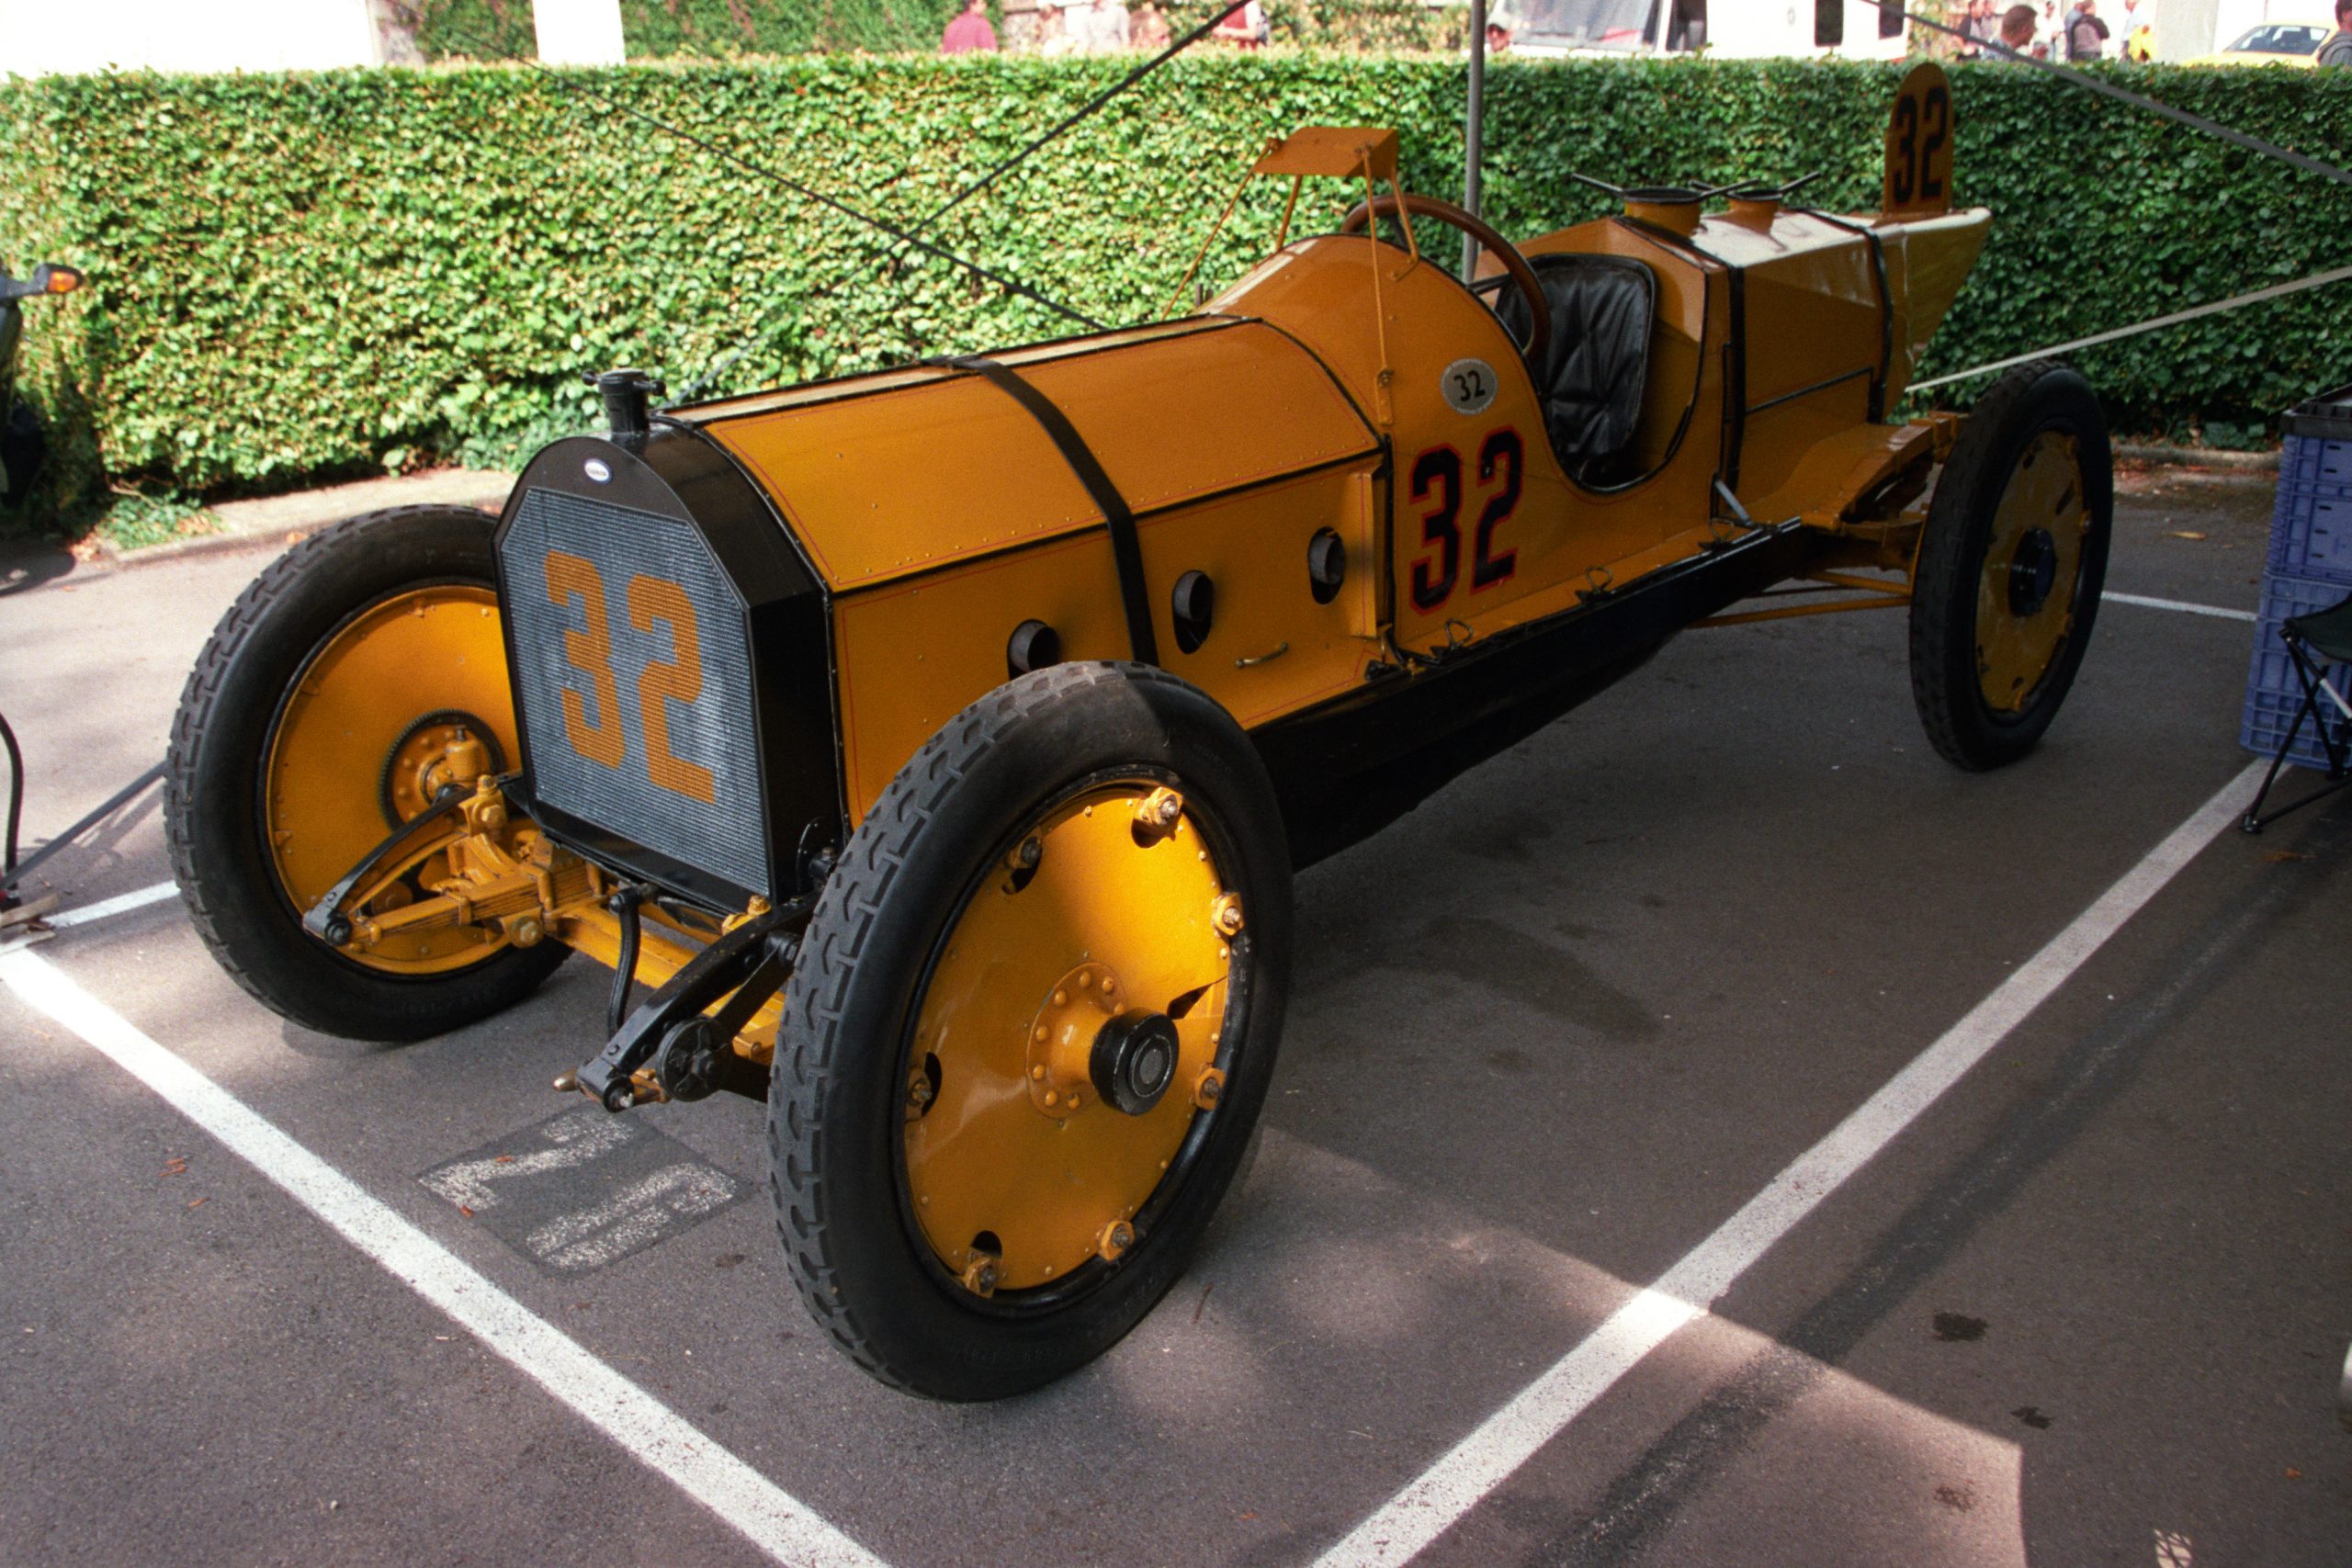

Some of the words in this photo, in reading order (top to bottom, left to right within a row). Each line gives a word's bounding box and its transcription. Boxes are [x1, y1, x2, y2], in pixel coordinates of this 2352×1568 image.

[1893, 86, 1949, 204] 32
[1453, 369, 1487, 402] 32
[1409, 424, 1524, 616] 32
[544, 550, 716, 805] 32
